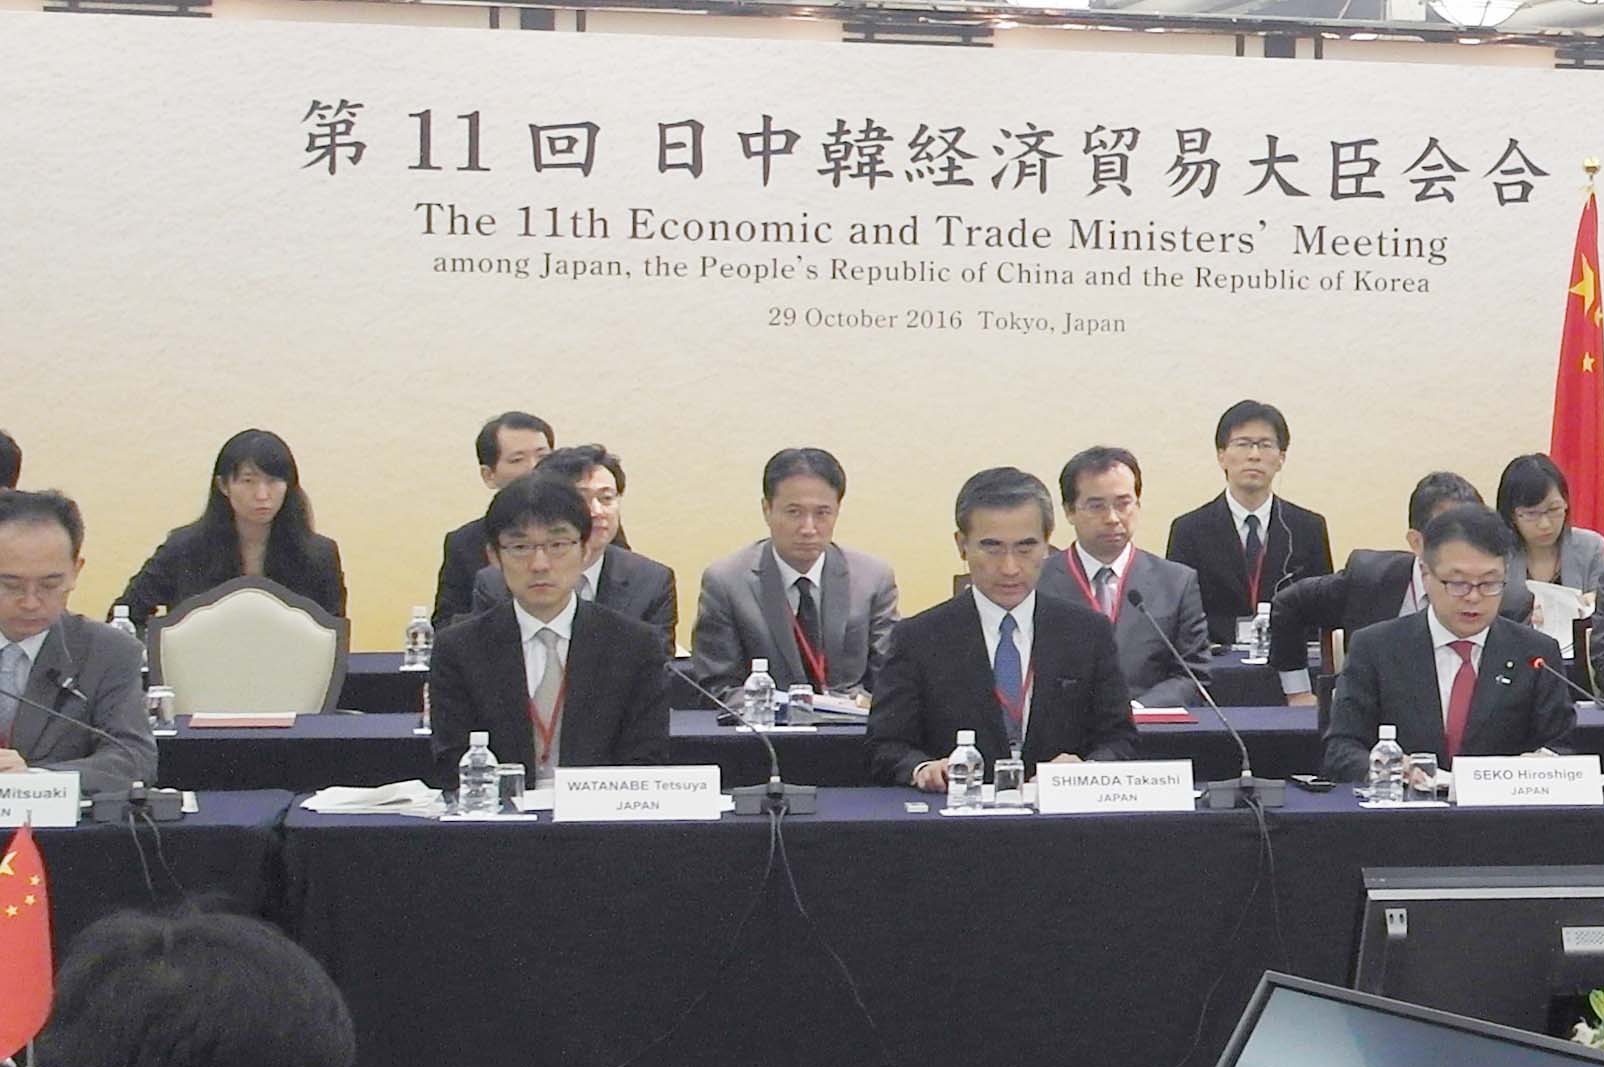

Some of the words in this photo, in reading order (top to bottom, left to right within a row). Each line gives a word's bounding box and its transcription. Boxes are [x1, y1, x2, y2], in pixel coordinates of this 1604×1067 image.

[414, 202, 498, 237] The
[517, 205, 610, 240] 11th
[628, 208, 833, 245] Economic
[848, 215, 920, 246] and
[936, 215, 1053, 249] Trade
[1293, 224, 1449, 266] Meeting
[433, 255, 531, 280] among
[540, 252, 632, 281] Japan,
[643, 255, 689, 278] the
[830, 258, 952, 286] Republic
[961, 260, 988, 284] of
[997, 260, 1075, 286] China
[1085, 265, 1133, 287] and
[1143, 266, 1185, 290] the
[1195, 266, 1310, 294] Republic
[1320, 270, 1346, 293] of
[1354, 270, 1431, 294] Korea
[768, 306, 798, 328] 29
[805, 307, 899, 330] October
[906, 308, 964, 331] 2016
[977, 309, 1056, 335] Tokyo,
[1062, 312, 1128, 336] Japan
[1052, 775, 1122, 787] SHIMADA
[1126, 774, 1180, 786] Takashi
[1473, 769, 1513, 780] SEKO
[1518, 769, 1583, 782] Hiroshige
[567, 780, 649, 791] WATANABE
[654, 779, 708, 792] Tetsuya
[1511, 787, 1549, 796] JAPAN
[1097, 793, 1138, 802] JAPAN
[616, 800, 660, 810] JAPAN
